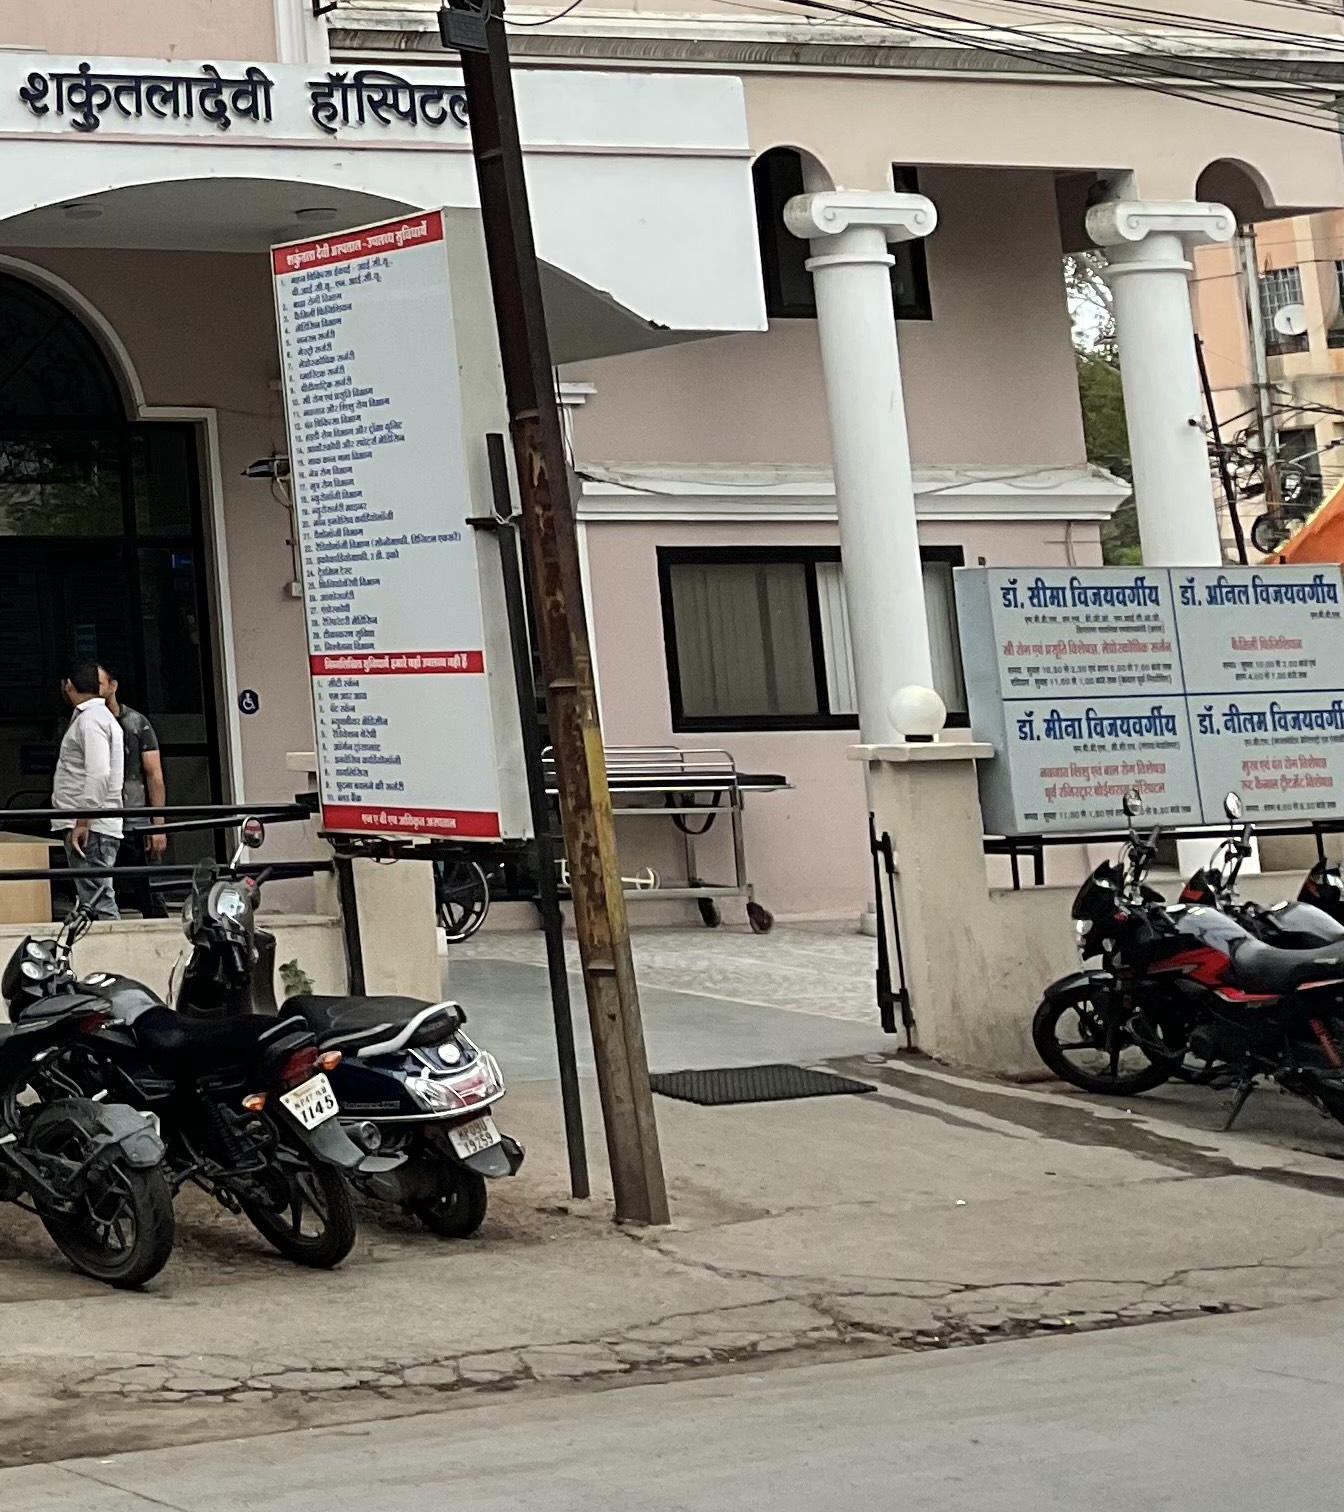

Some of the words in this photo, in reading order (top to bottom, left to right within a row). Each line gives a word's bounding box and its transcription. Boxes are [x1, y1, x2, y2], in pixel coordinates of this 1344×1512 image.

[19, 63, 273, 131] शकुंतलादेवी
[1001, 579, 1024, 608] डॉ.
[1027, 577, 1067, 607] सीमा
[1070, 576, 1160, 607] विजयवर्गीय
[1179, 577, 1201, 606] डॉ.
[1205, 575, 1249, 605] अनिल
[1252, 574, 1338, 604] विजयवर्गीय
[1017, 711, 1040, 740] डॉ.
[1043, 709, 1083, 740] मीना
[1086, 706, 1177, 738] विजयवर्गीय
[1197, 705, 1220, 735] डॉ.
[1222, 704, 1268, 733] नीलम
[1270, 700, 1344, 732] विजयवर्गी
[302, 1095, 333, 1123] 1145
